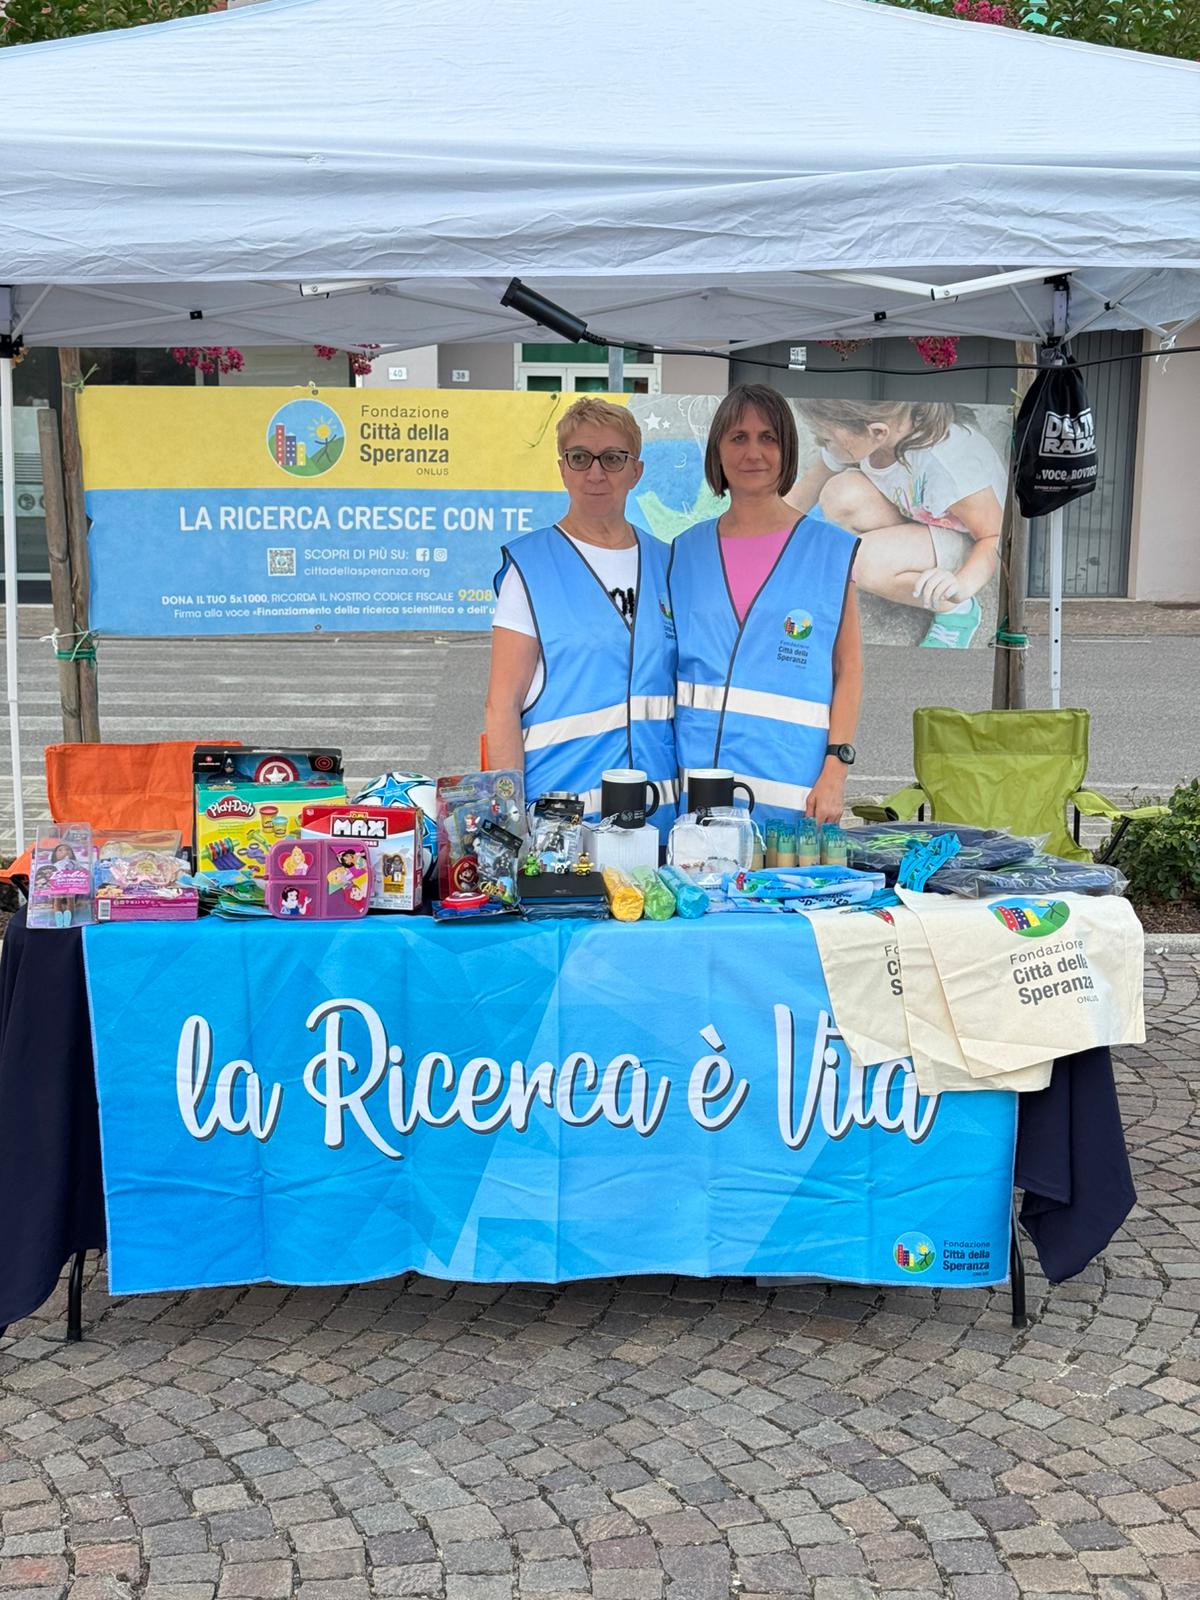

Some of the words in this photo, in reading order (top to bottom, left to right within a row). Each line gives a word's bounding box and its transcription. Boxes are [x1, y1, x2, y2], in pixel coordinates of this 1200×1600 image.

[392, 369, 403, 378] 40
[361, 405, 449, 418] Fondazione
[360, 422, 401, 440] Città
[407, 424, 449, 440] della
[360, 444, 449, 466] Speranza
[416, 468, 448, 476] ONLUS
[179, 506, 212, 531] LA
[220, 506, 332, 530] RICERCA
[337, 506, 437, 530] CRESCE
[443, 507, 494, 532] CON
[501, 508, 534, 532] TE
[304, 548, 350, 560] SCOPRI
[354, 549, 366, 560] DI
[368, 546, 388, 560] PIÙ
[390, 549, 409, 560] SU:
[304, 567, 430, 578] cittadellasperanza.org
[162, 595, 194, 606] DONA
[196, 595, 206, 604] IL
[206, 594, 227, 604] TUO
[272, 593, 318, 602] RICORDA
[320, 593, 328, 602] IL
[330, 592, 370, 602] NOSTRO
[373, 592, 412, 602] CODICE
[416, 592, 454, 601] FISCALE
[458, 590, 493, 602] 9208
[174, 609, 202, 618] Firma
[204, 609, 222, 618] alla
[334, 606, 360, 616] della
[362, 606, 400, 615] ricerca
[402, 605, 454, 614] scientifica
[776, 653, 808, 665] Speranza
[333, 818, 385, 836] MAX
[1013, 961, 1054, 984] Città
[1057, 954, 1088, 973] della
[1018, 976, 1094, 1006] Speranza
[176, 1014, 282, 1142] la
[302, 997, 672, 1162] Ricerca
[688, 1022, 749, 1131] è
[944, 1240, 990, 1248] Fondazione
[943, 1249, 965, 1260] Città
[968, 1250, 990, 1260] della
[943, 1260, 990, 1272] Speranza
